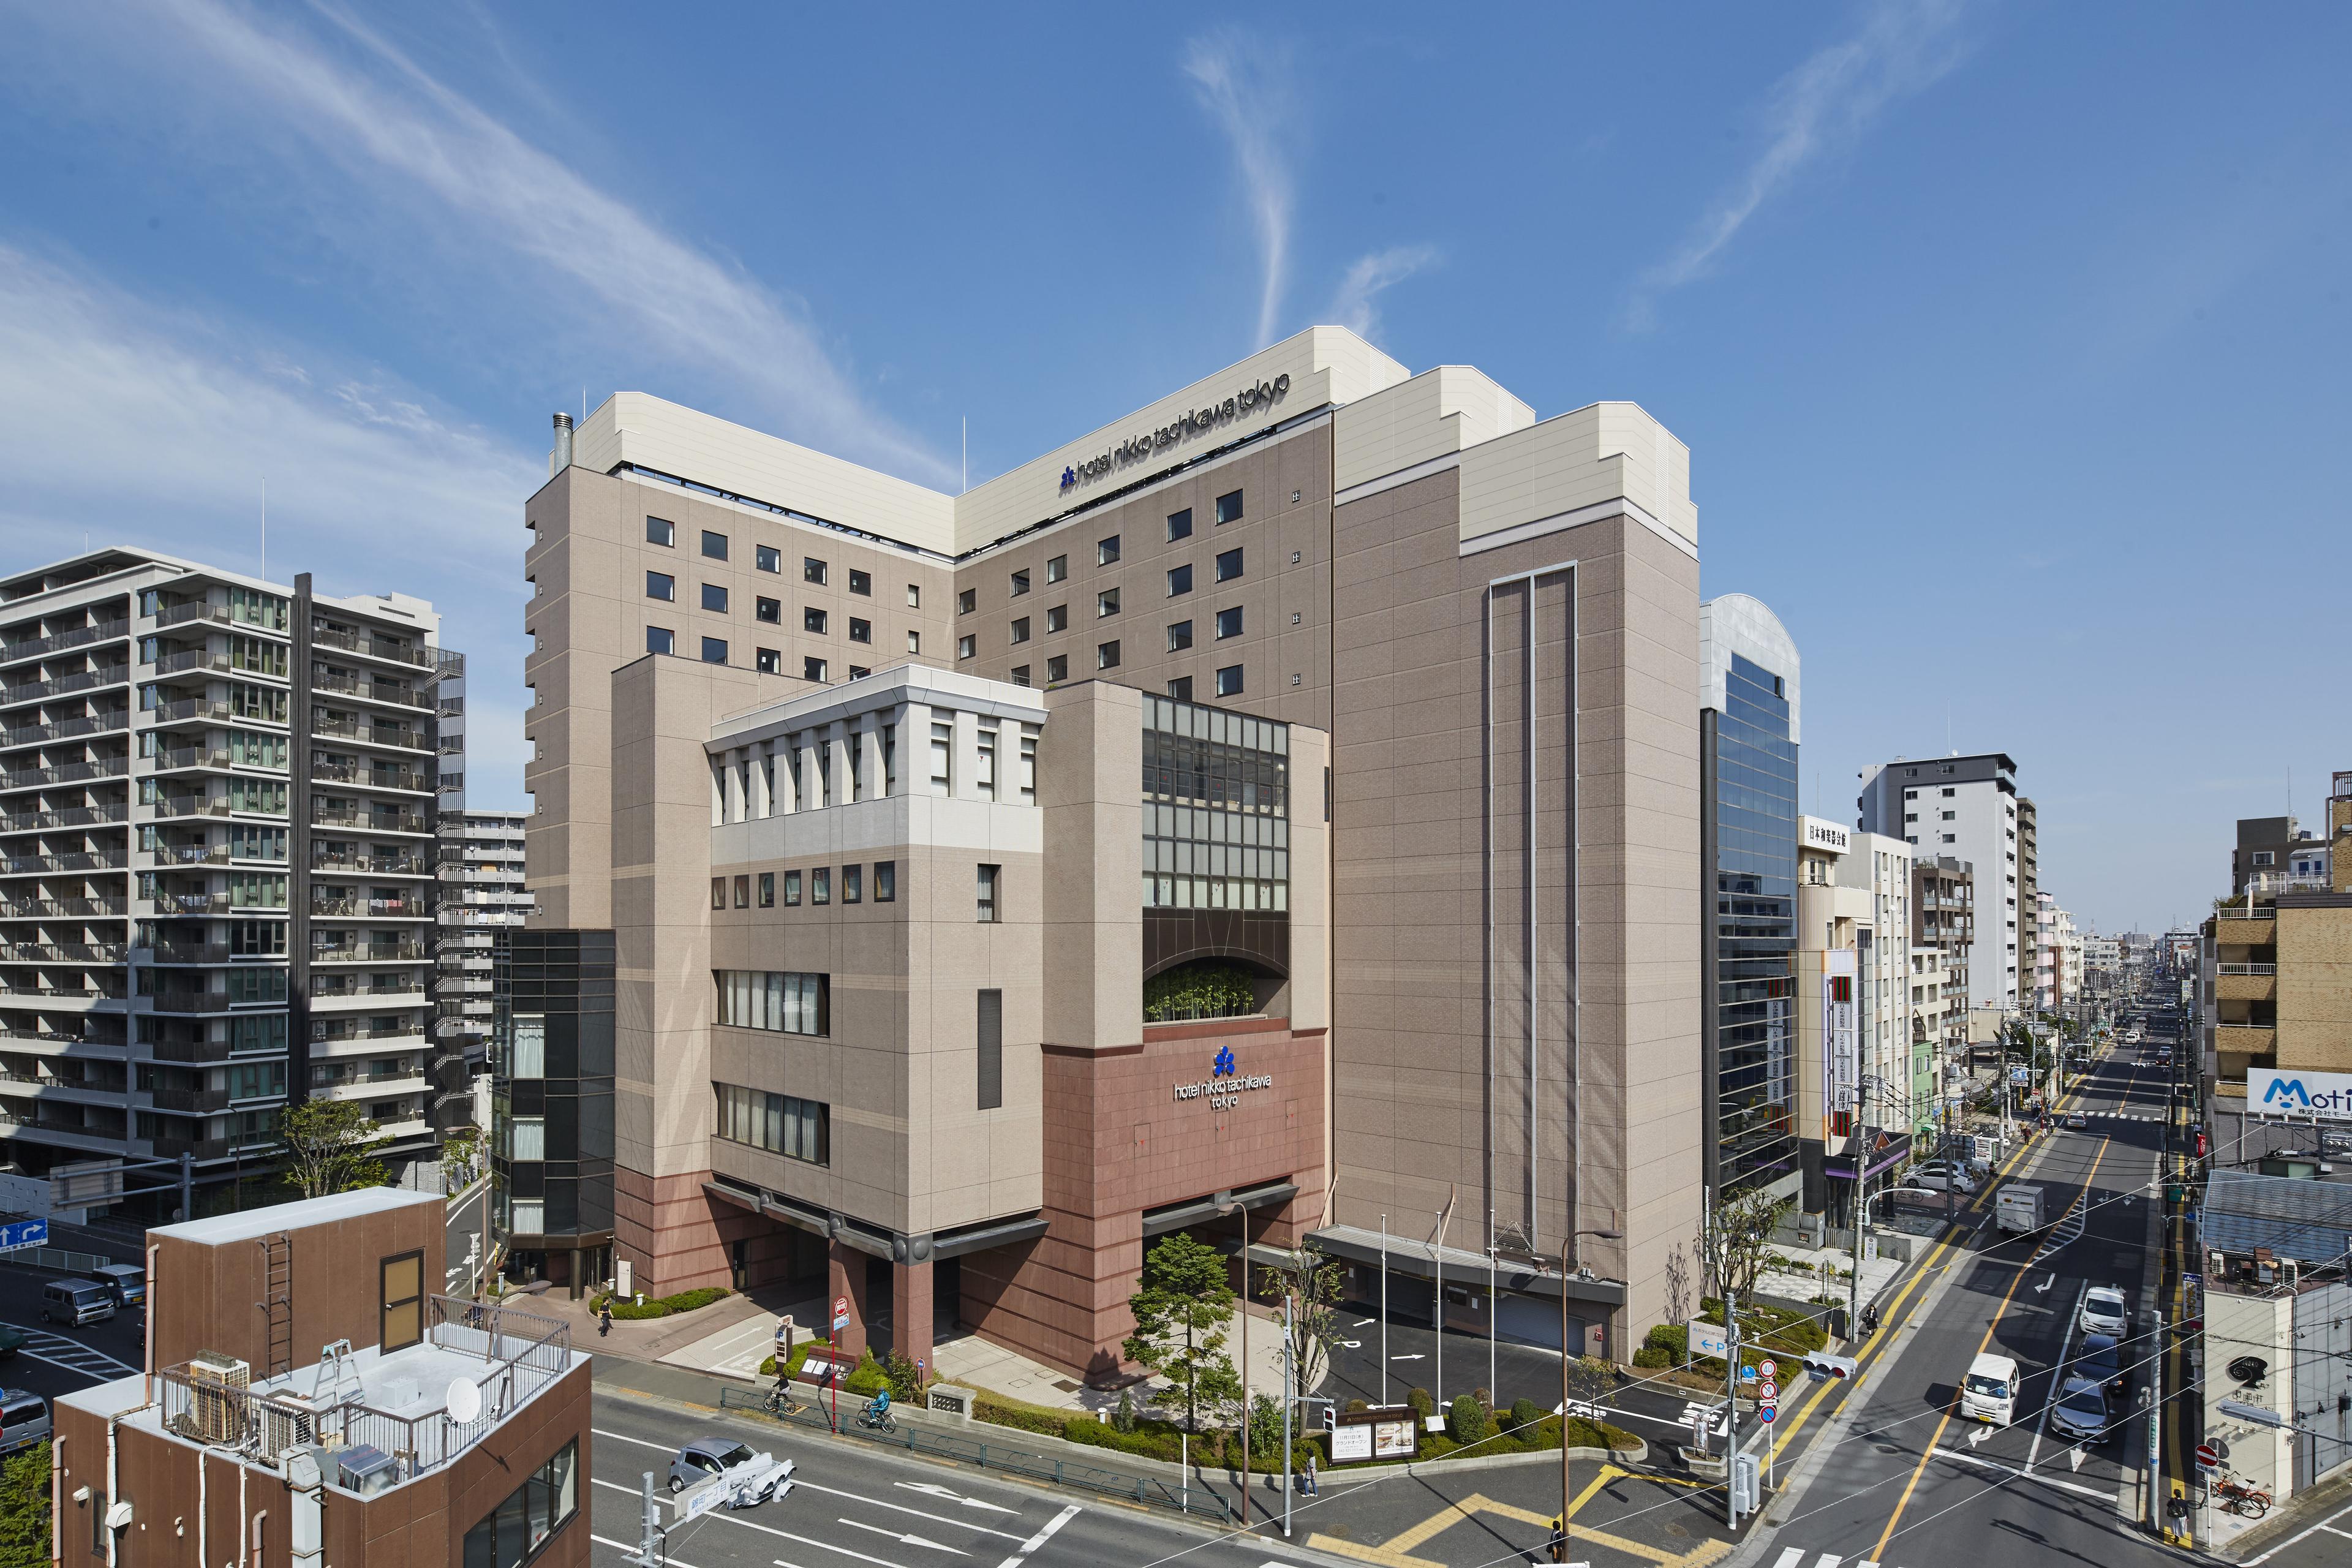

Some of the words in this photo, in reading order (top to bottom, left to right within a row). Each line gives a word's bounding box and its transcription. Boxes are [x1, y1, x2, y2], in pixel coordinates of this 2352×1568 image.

[1077, 447, 1112, 481] hotel
[1114, 434, 1152, 466] nikko
[1153, 397, 1234, 448] tachikawa
[1237, 373, 1290, 411] tokyo
[1174, 1081, 1200, 1099] hotel
[1201, 1079, 1226, 1095] nikko
[1227, 1074, 1272, 1092] tachikawa
[1212, 1095, 1238, 1109] tokyo
[778, 1331, 784, 1340] P
[1717, 1342, 1725, 1352] P
[691, 1481, 726, 1510] 錦町一丁目
